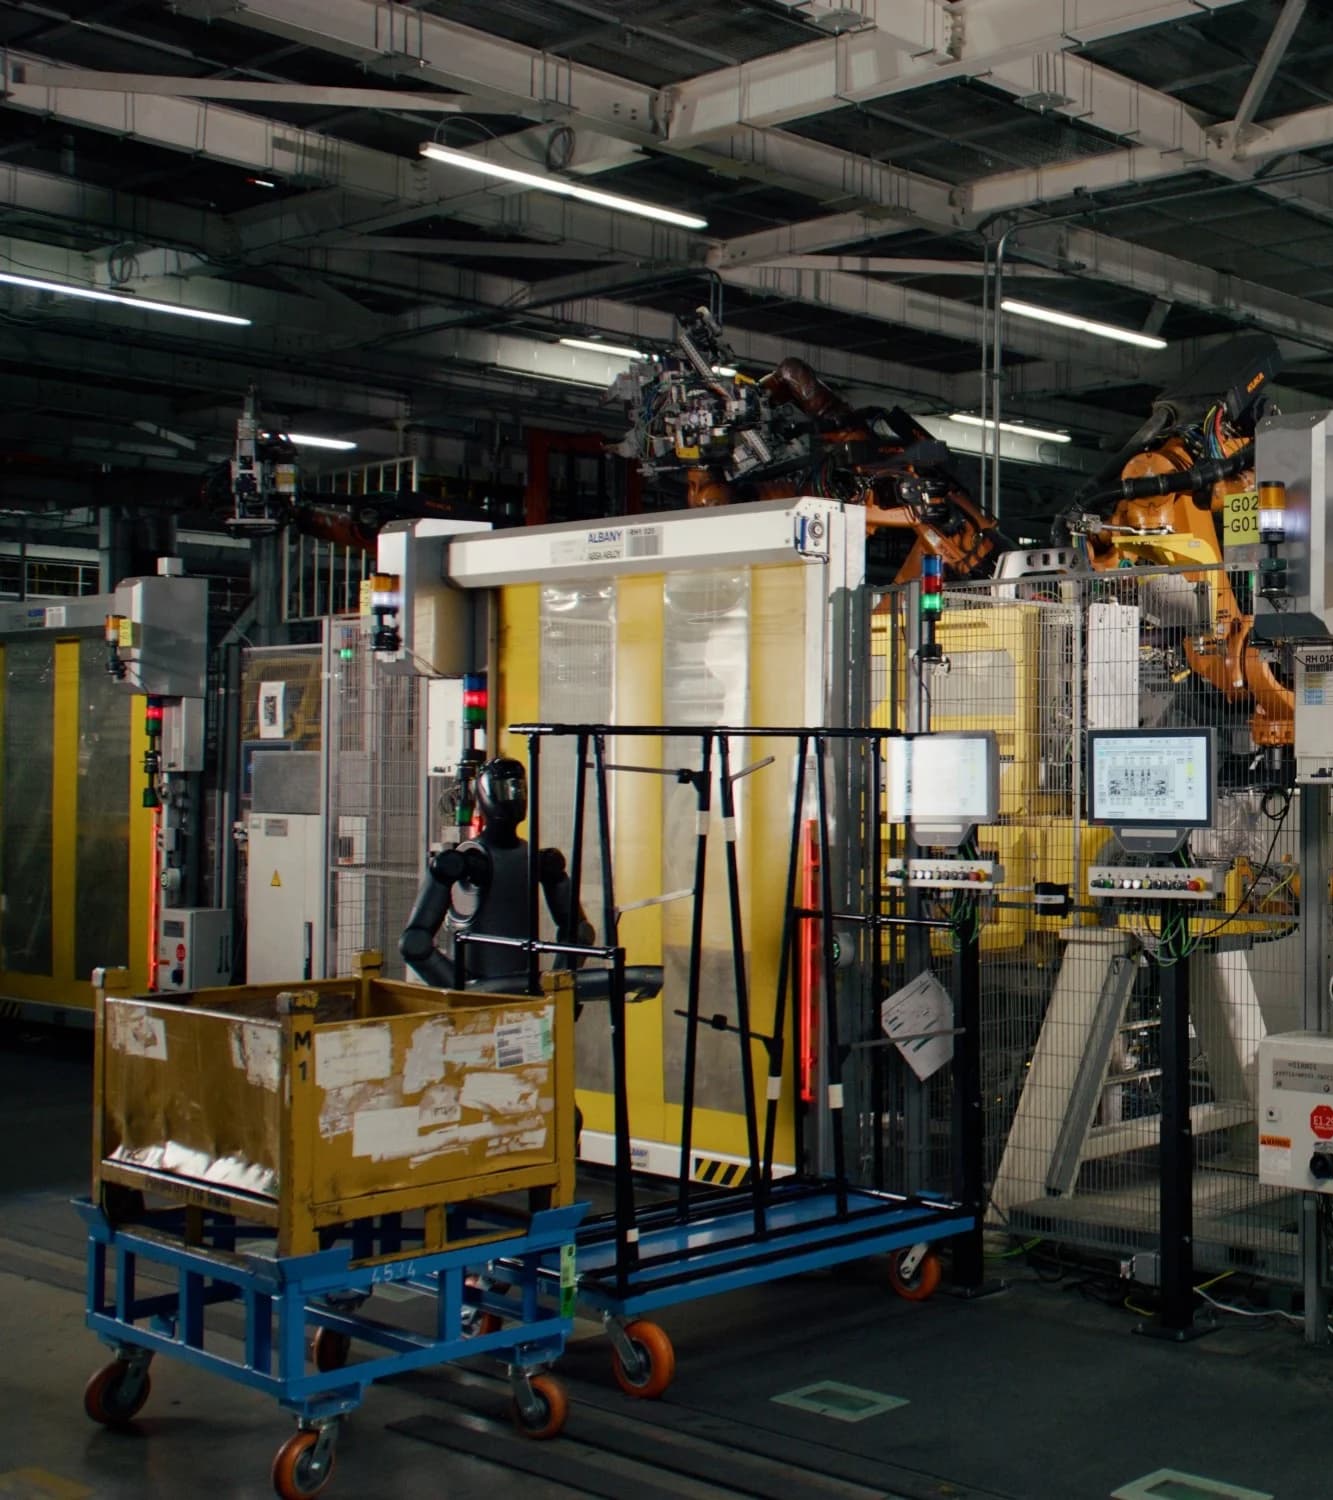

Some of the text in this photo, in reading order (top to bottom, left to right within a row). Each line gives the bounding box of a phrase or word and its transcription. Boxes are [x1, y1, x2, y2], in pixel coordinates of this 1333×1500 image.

[587, 529, 624, 544] ALBANY
[1305, 654, 1318, 665] RH
[294, 1030, 312, 1052] M
[298, 1060, 308, 1082] 1
